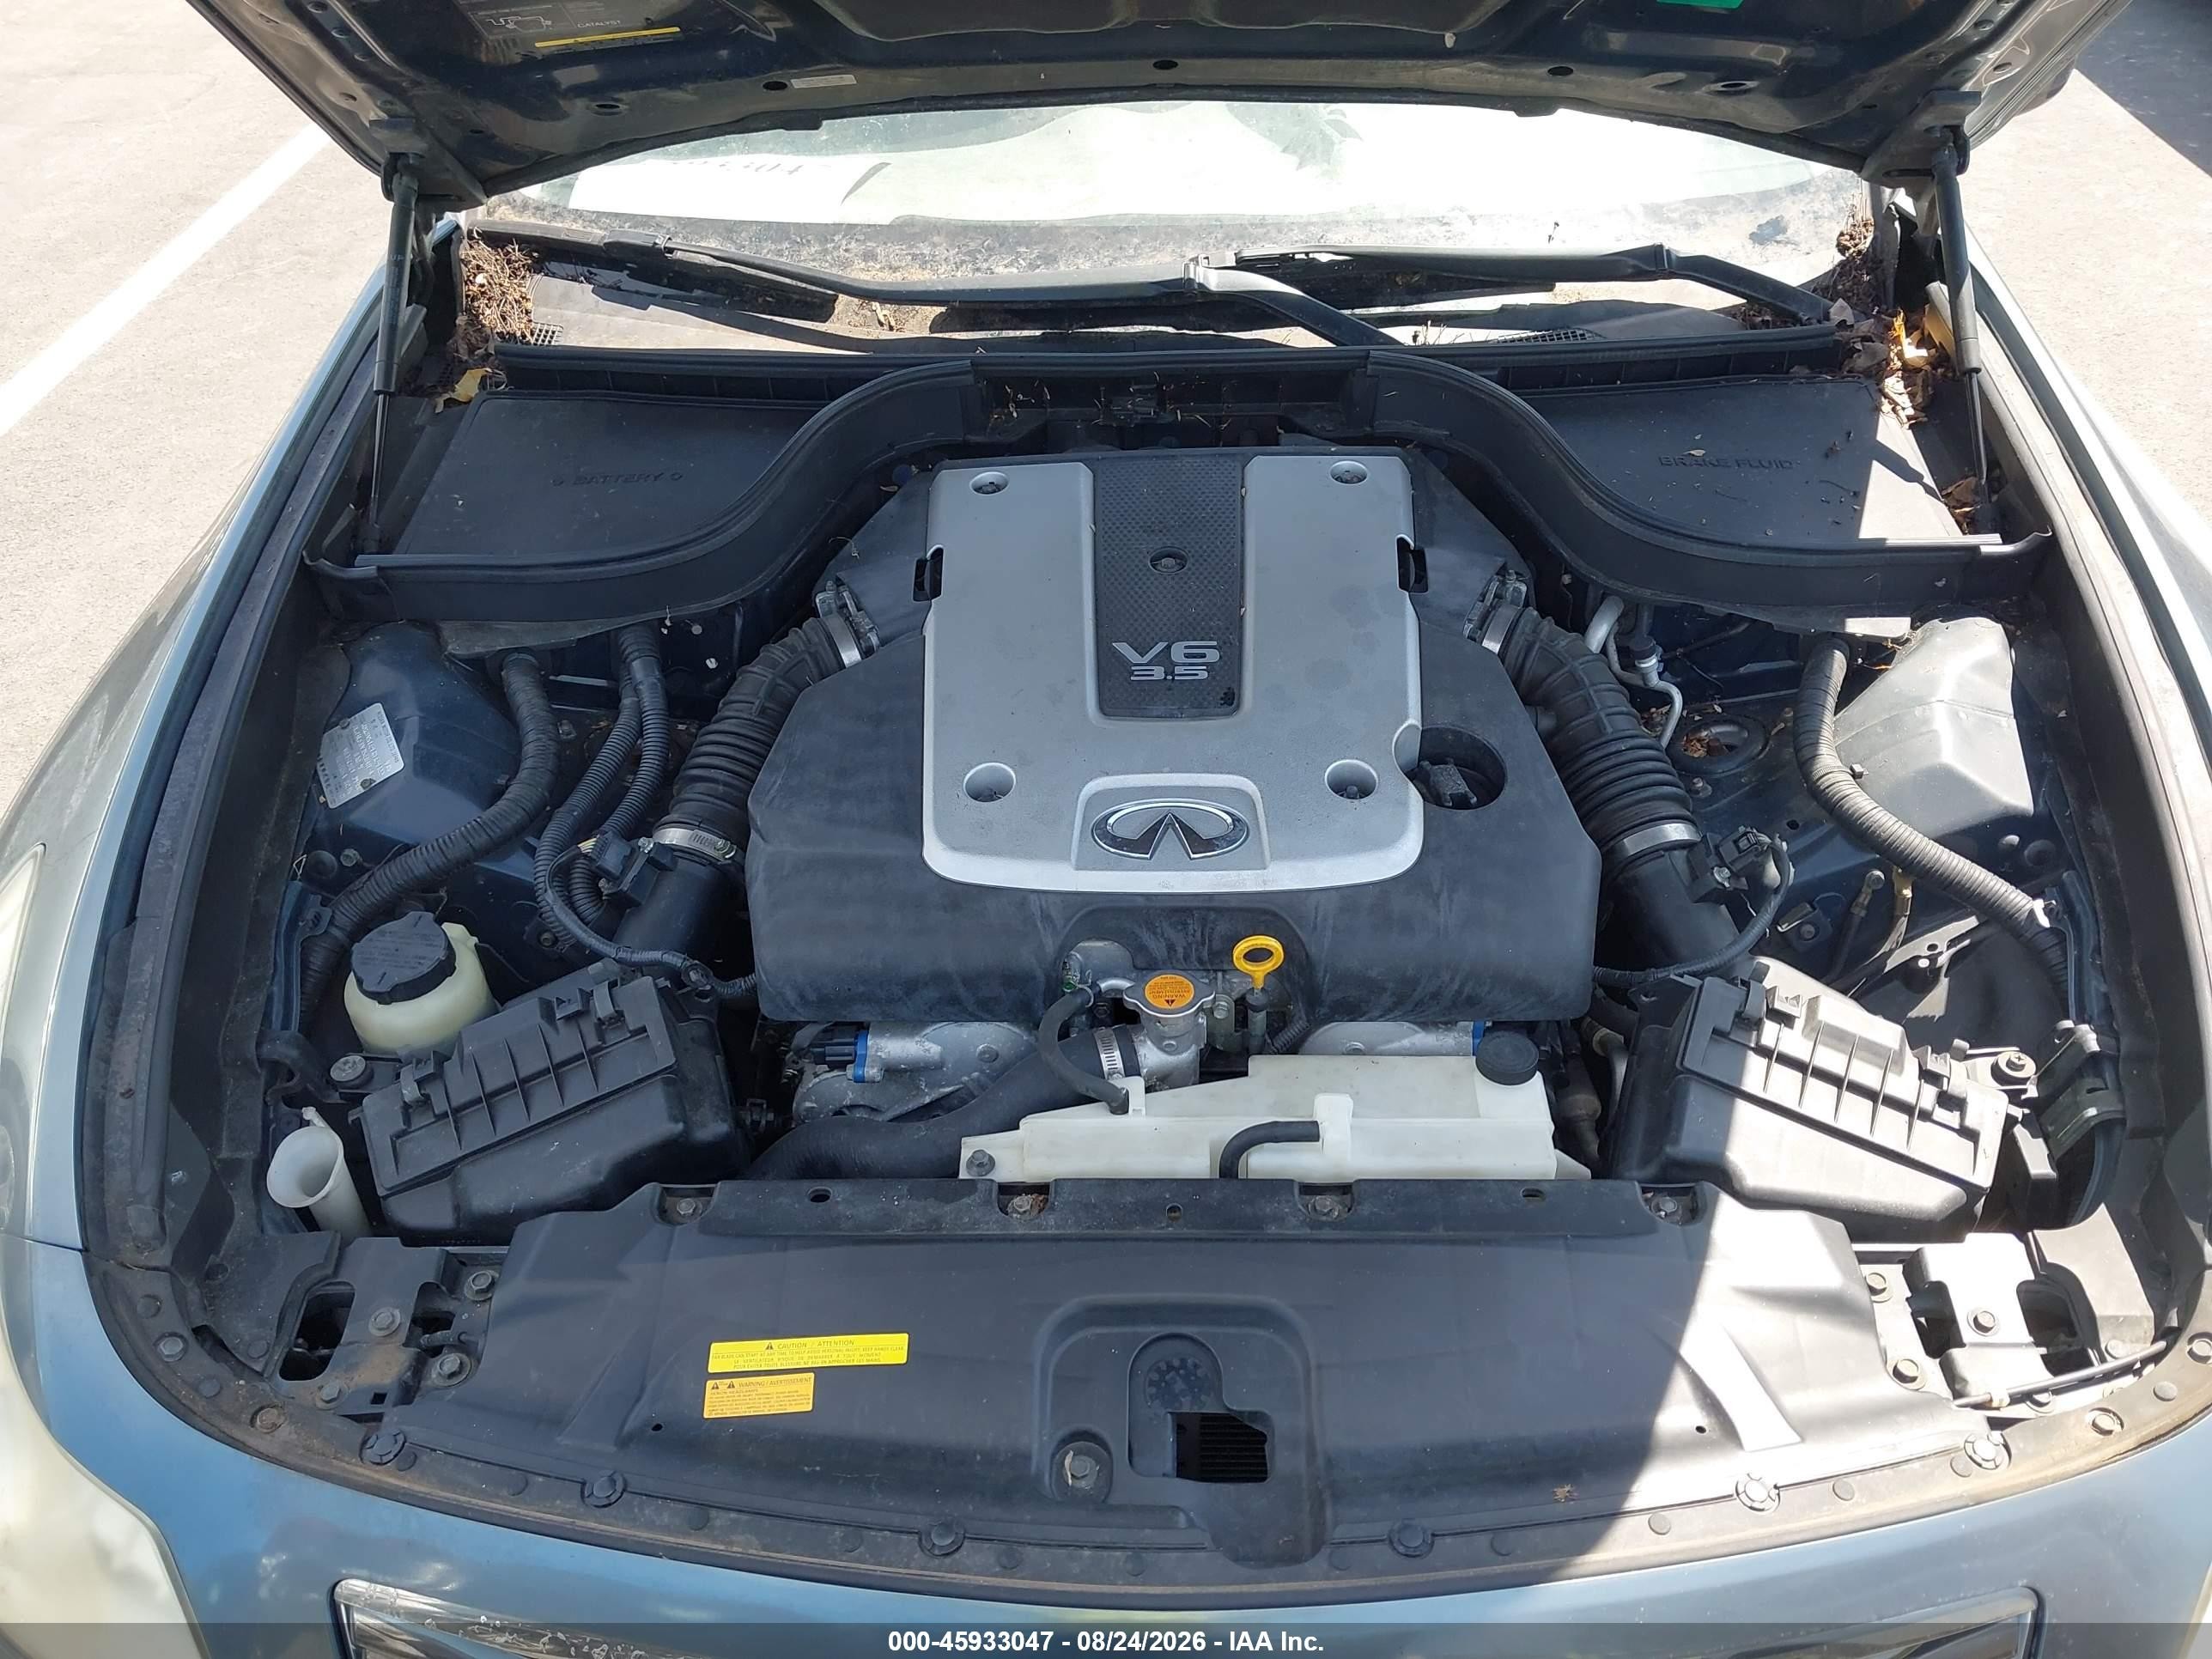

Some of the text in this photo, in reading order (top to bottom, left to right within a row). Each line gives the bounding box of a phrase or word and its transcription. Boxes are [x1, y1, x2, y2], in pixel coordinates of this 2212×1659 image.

[577, 20, 621, 28] CATALYST
[1658, 456, 1794, 469] BRAKE FLUID
[572, 472, 665, 485] BATTERY
[1112, 641, 1220, 664] V6
[1130, 665, 1208, 681] 3.5
[817, 1339, 854, 1347] ATTENTION
